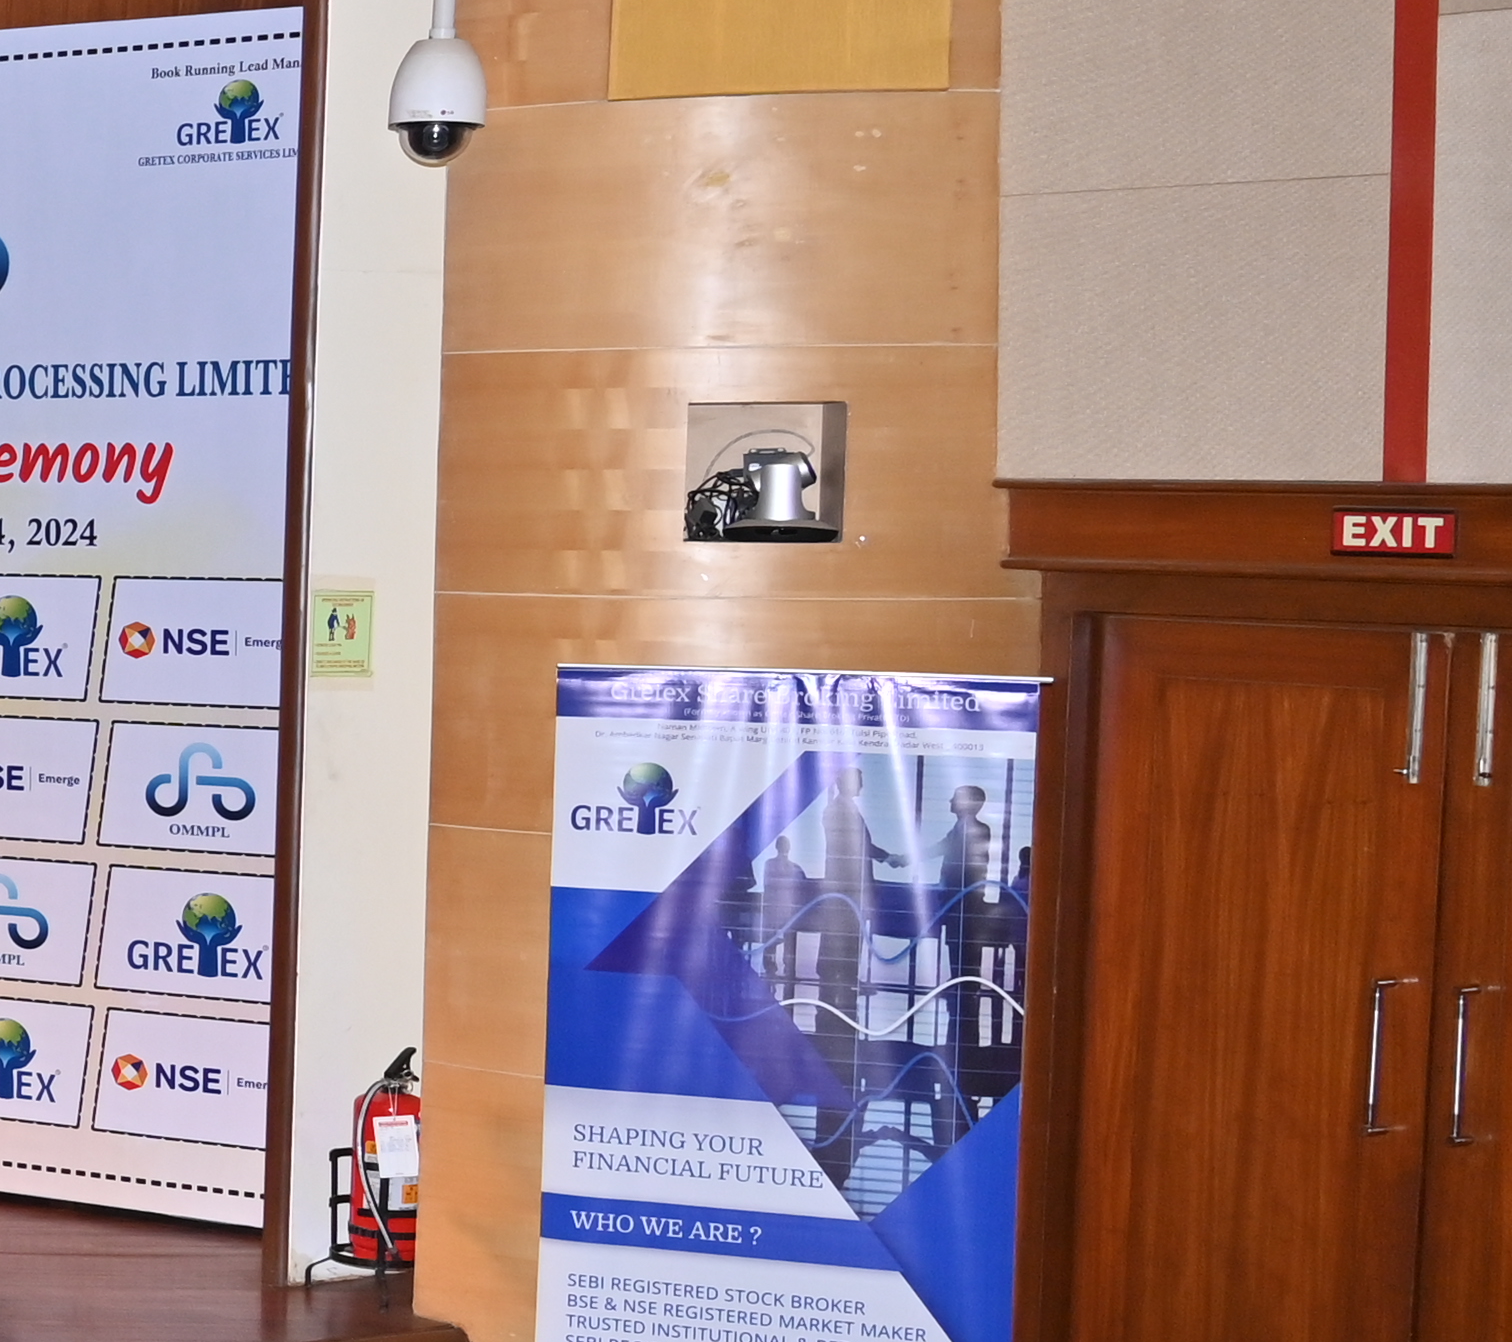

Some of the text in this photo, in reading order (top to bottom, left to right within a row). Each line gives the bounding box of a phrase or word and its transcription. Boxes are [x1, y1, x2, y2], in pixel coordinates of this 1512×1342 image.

[151, 58, 269, 80] Book Running Lead
[177, 100, 279, 145] GRETEX
[137, 148, 281, 167] GRETEX CORPORATE SERVICES
[26, 518, 98, 547] 2024
[1343, 515, 1444, 548] EXIT
[162, 628, 230, 656] NSE
[570, 786, 697, 837] GRETEX
[169, 823, 230, 839] OMMPL
[573, 1123, 764, 1157] SHAPING YOUR
[572, 1150, 824, 1189] FINANCIAL FUTURE
[569, 1210, 743, 1244] WHO WE ARE
[567, 1273, 866, 1316] SEBI REGISTERED STOCK BROKER
[566, 1313, 646, 1335] TRUSTED
[567, 1293, 926, 1342] BSE & NSE REGISTERED MARKET MAKER
